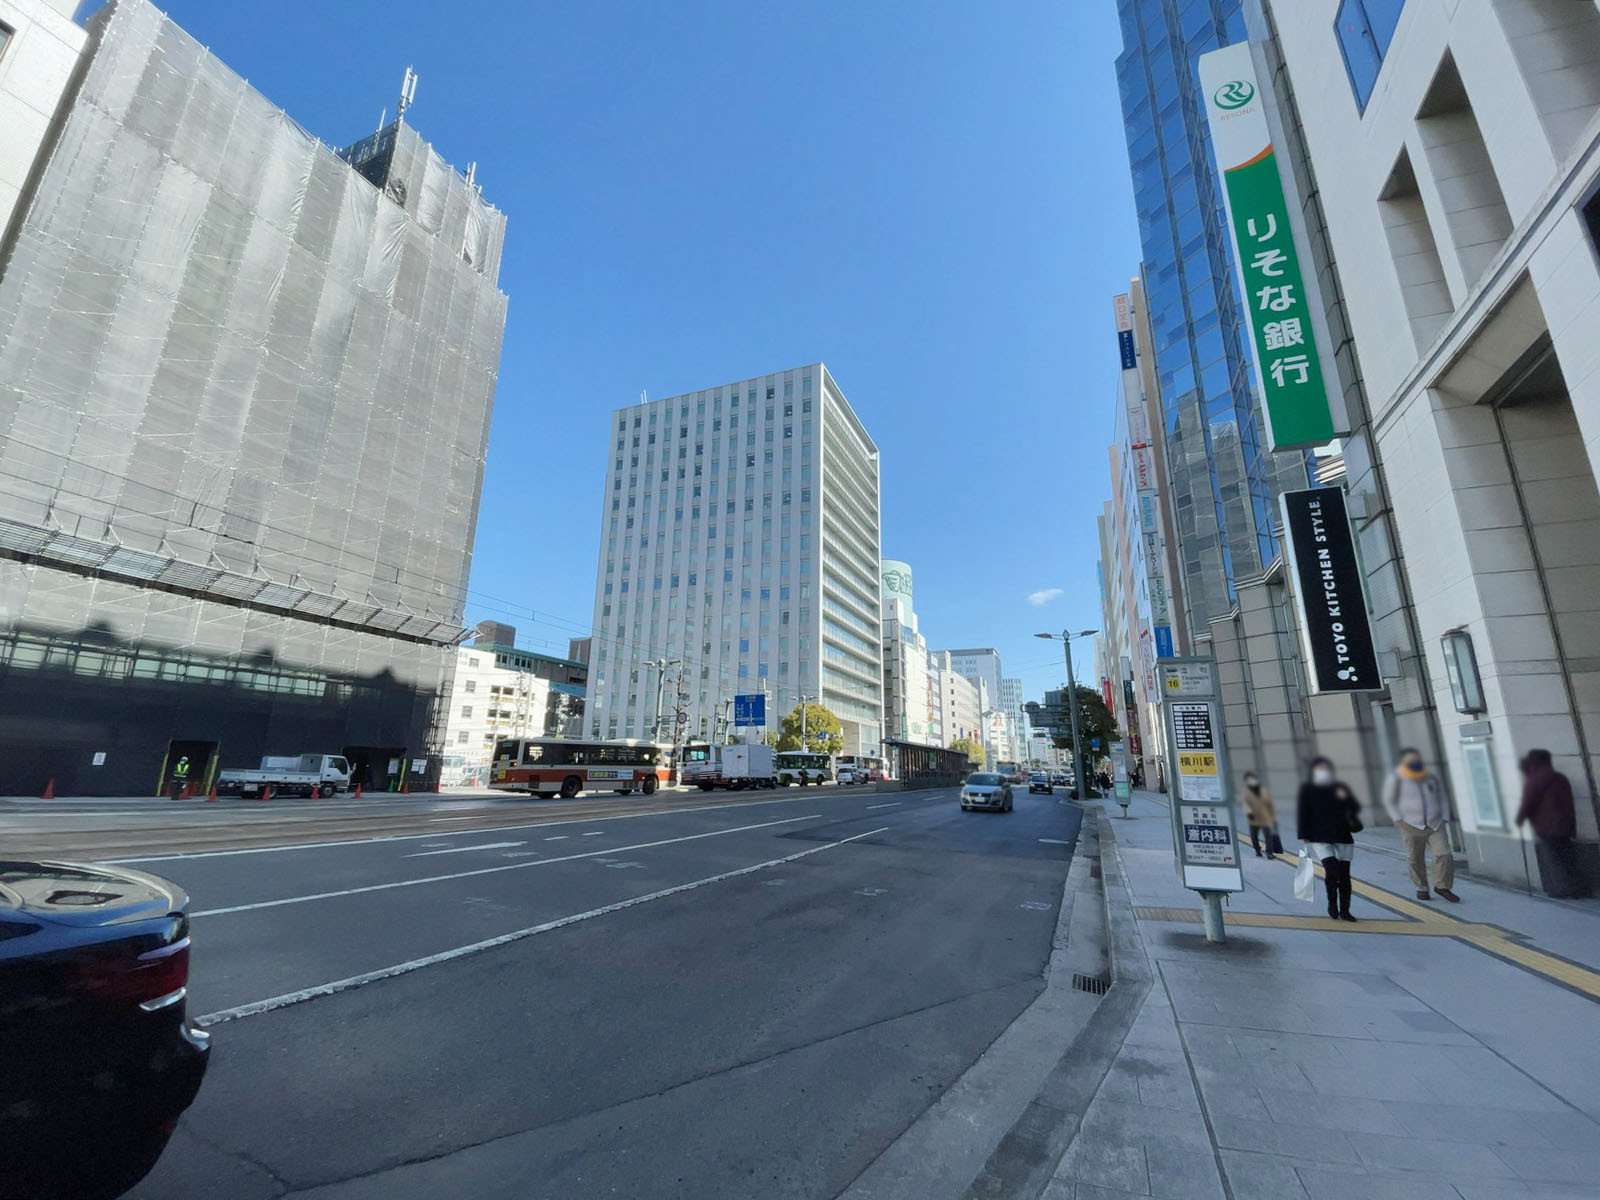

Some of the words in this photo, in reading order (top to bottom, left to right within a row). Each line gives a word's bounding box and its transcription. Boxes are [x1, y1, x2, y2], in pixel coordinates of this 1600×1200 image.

[1247, 213, 1310, 388] りそな銀行
[1318, 548, 1342, 617] KITCHEN
[1332, 622, 1350, 664] TOYO
[1168, 680, 1179, 688] 16
[1180, 756, 1216, 767] 横川駅
